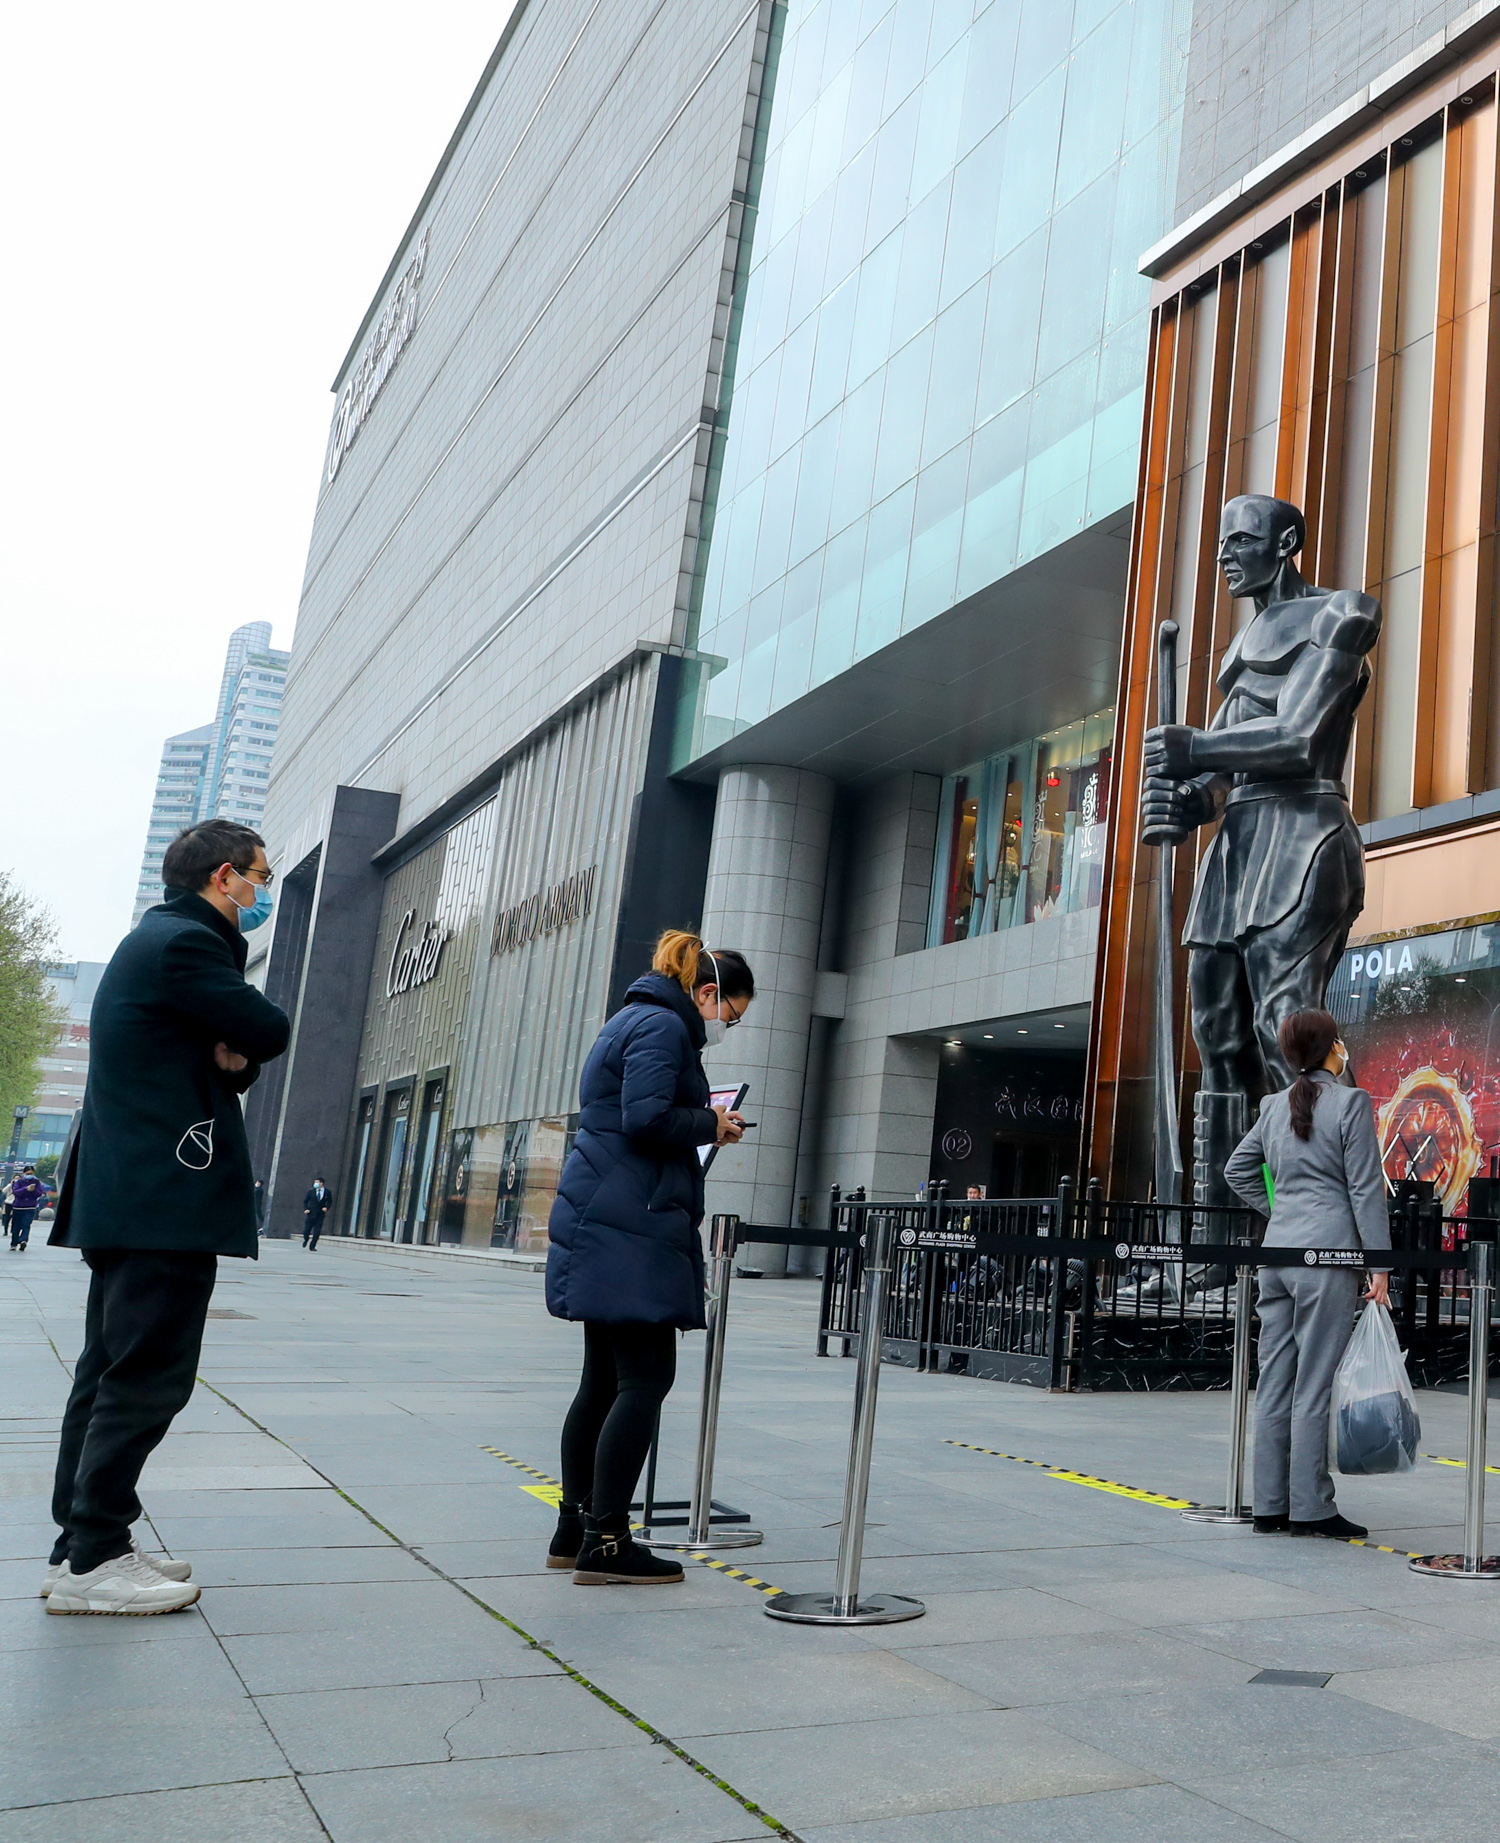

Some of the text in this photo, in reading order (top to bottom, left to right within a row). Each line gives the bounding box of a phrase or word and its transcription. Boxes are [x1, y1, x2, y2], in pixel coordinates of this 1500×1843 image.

[490, 864, 597, 957] GIORGIO ARMANI
[386, 908, 448, 998] Cartier
[1350, 945, 1413, 981] POLA
[15, 1107, 28, 1116] M
[946, 1136, 967, 1152] 02
[918, 1230, 977, 1242] 武商广场购物中心
